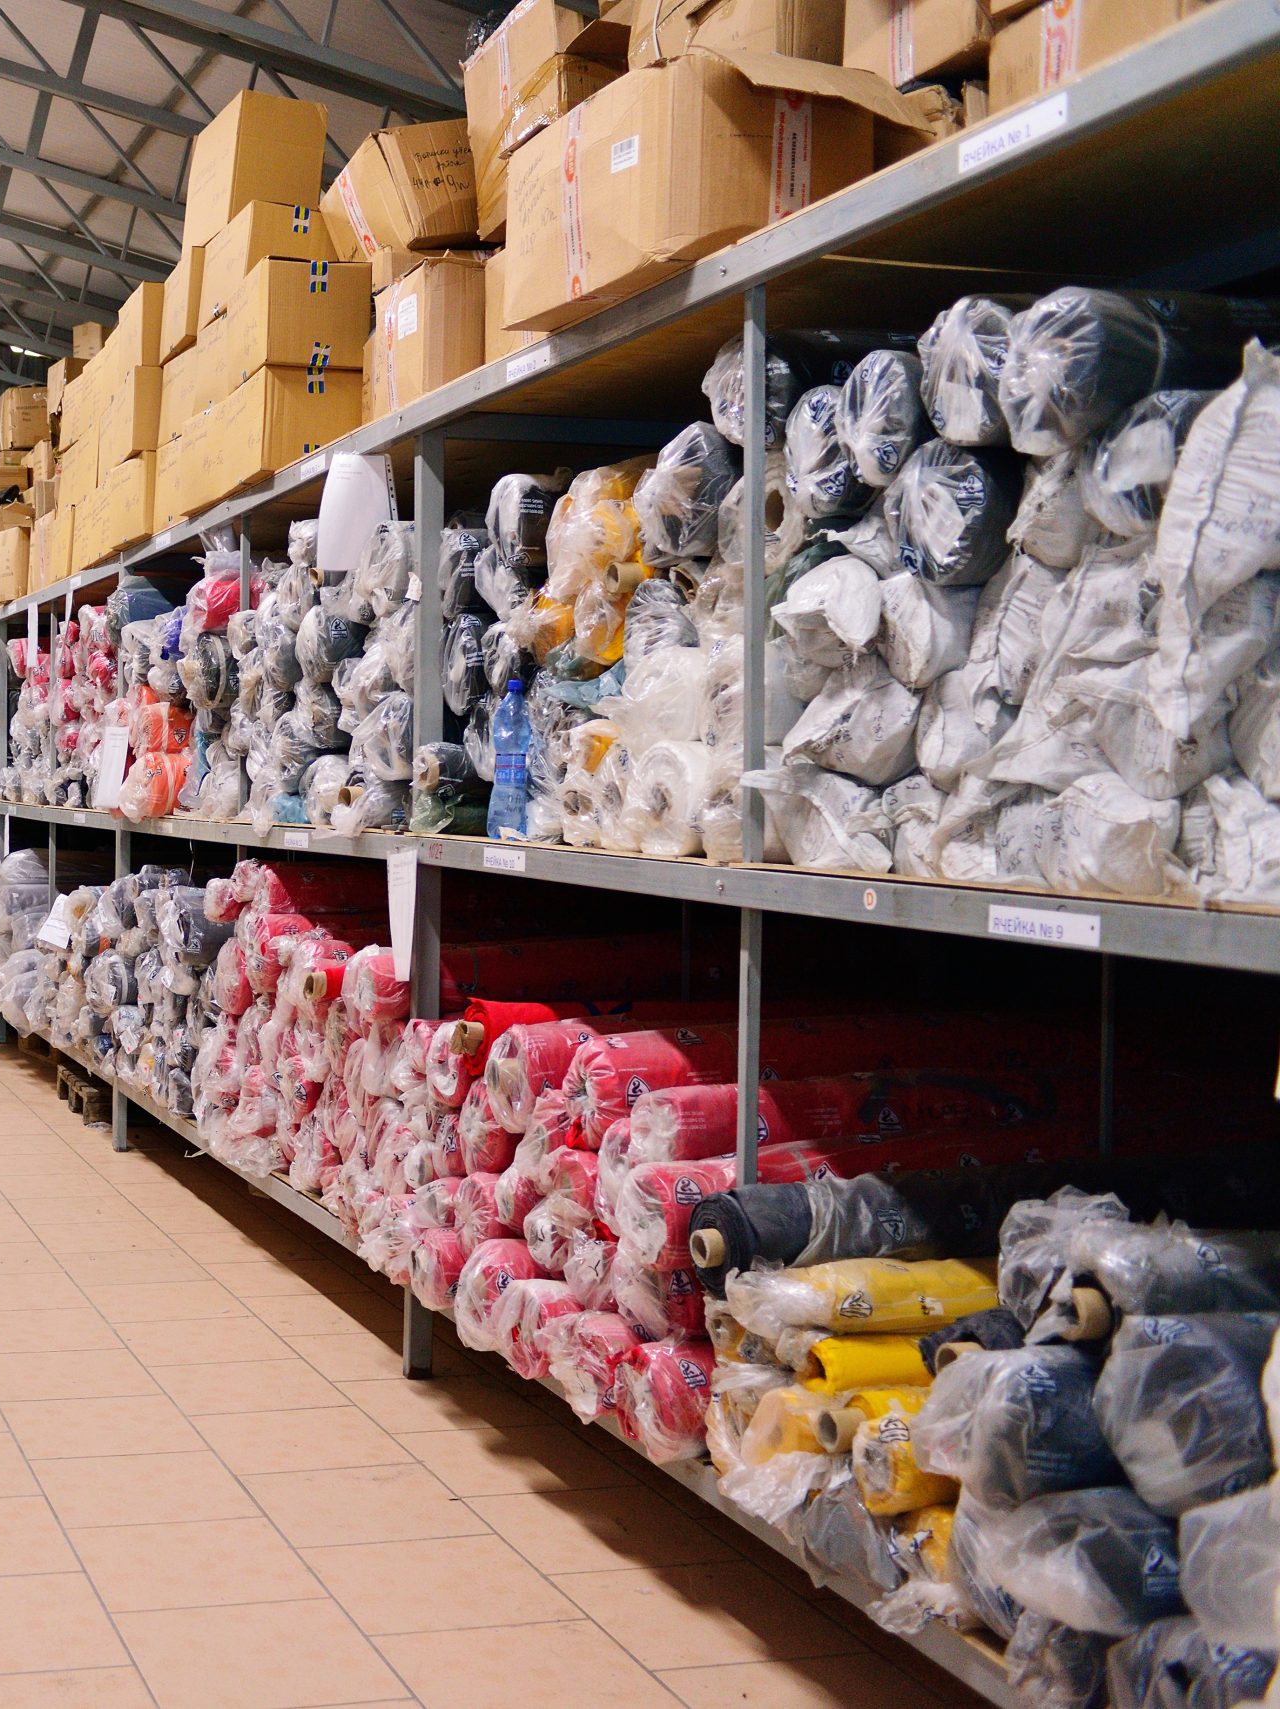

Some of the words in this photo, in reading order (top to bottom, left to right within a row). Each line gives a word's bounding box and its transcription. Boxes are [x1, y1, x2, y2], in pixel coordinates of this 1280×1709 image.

[963, 136, 1005, 168] ЯЧЕЙКА
[1024, 123, 1032, 138] 1
[992, 916, 1037, 936] ЯЧЕЙКА
[1040, 922, 1053, 938] №
[1056, 925, 1064, 939] 9
